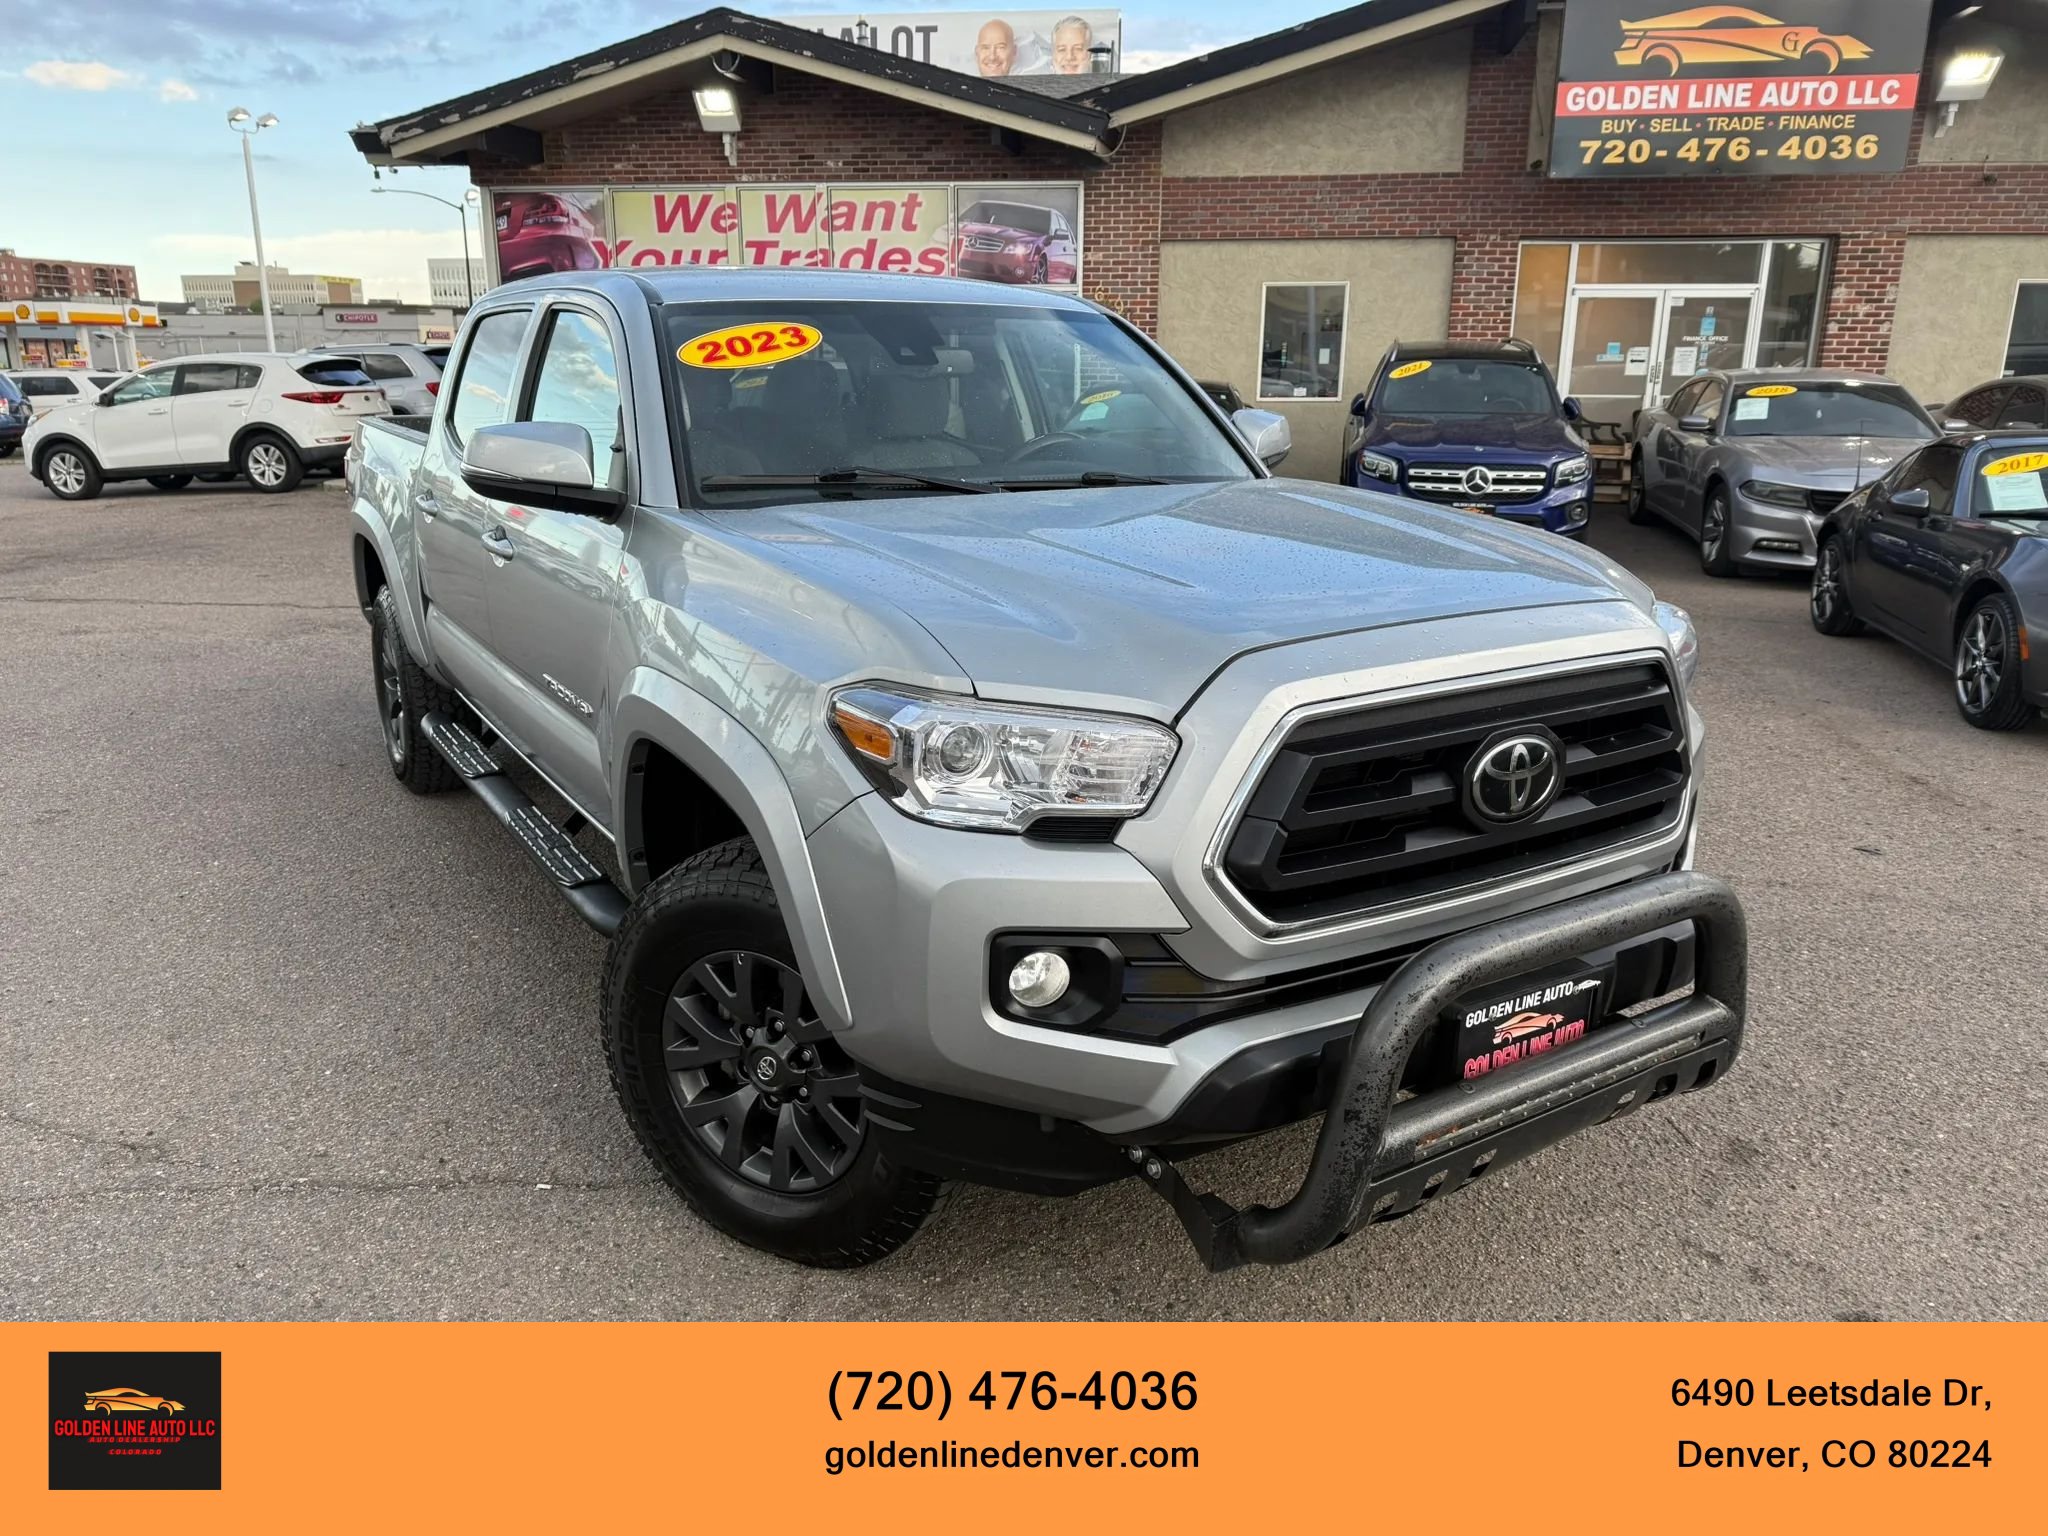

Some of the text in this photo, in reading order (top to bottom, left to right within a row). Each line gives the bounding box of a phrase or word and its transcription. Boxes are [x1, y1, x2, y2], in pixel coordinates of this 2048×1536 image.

[1566, 79, 1900, 112] GOLDEN LINE AUTO LLC
[1600, 114, 1856, 134] BUY SELL TRADE FINANCE
[653, 192, 924, 234] We Want
[697, 326, 810, 364] 2023
[1998, 454, 2044, 473] 2017
[1465, 981, 1574, 1028] GOLDEN LINE AUTO
